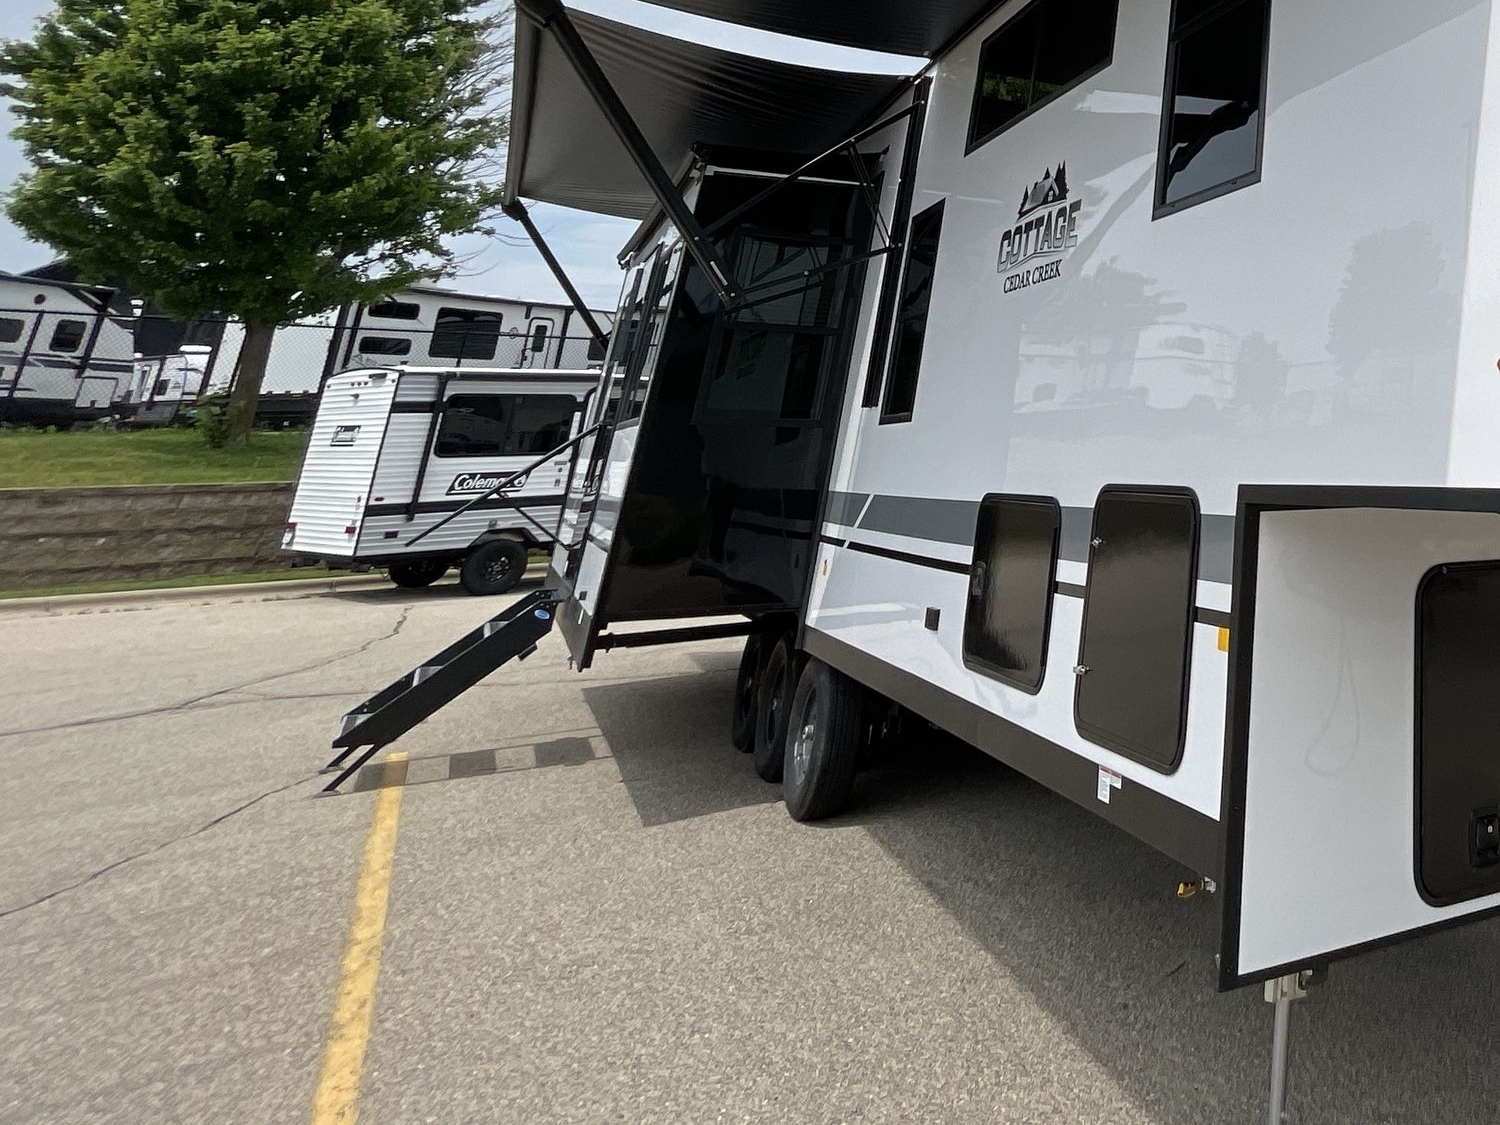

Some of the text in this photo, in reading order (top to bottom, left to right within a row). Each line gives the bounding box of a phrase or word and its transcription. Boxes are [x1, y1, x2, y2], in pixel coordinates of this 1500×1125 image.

[997, 198, 1082, 273] COTTAGE
[1003, 258, 1063, 294] CEDAR CREEK
